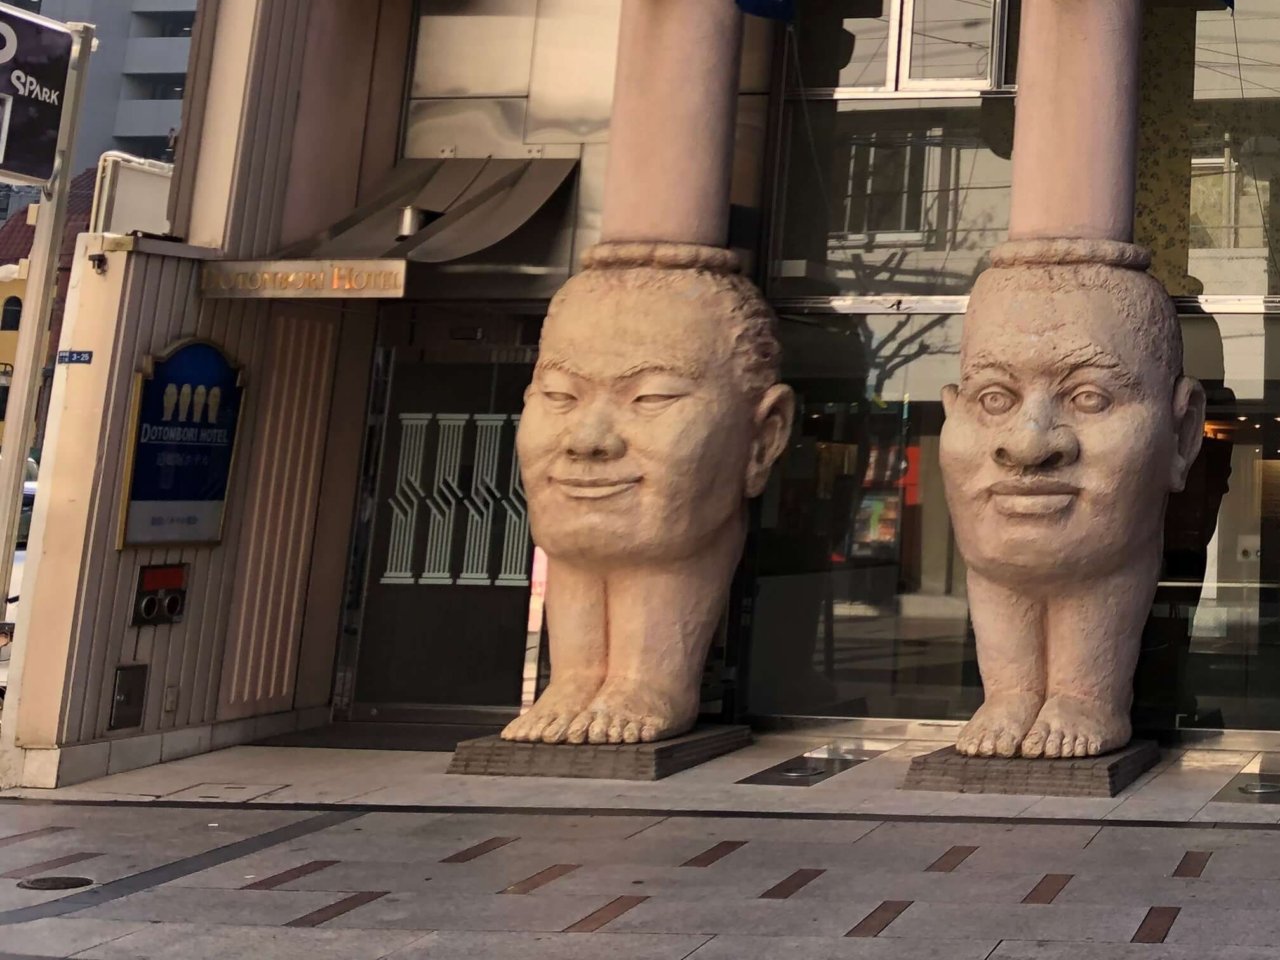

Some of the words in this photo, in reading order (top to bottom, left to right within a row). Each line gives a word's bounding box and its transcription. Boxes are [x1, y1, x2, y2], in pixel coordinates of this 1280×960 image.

[10, 68, 61, 107] SPARK
[201, 269, 325, 290] DOTONBORI
[331, 266, 402, 290] HOTEL
[140, 423, 198, 443] DOTONBORI
[200, 428, 229, 443] HOTEL
